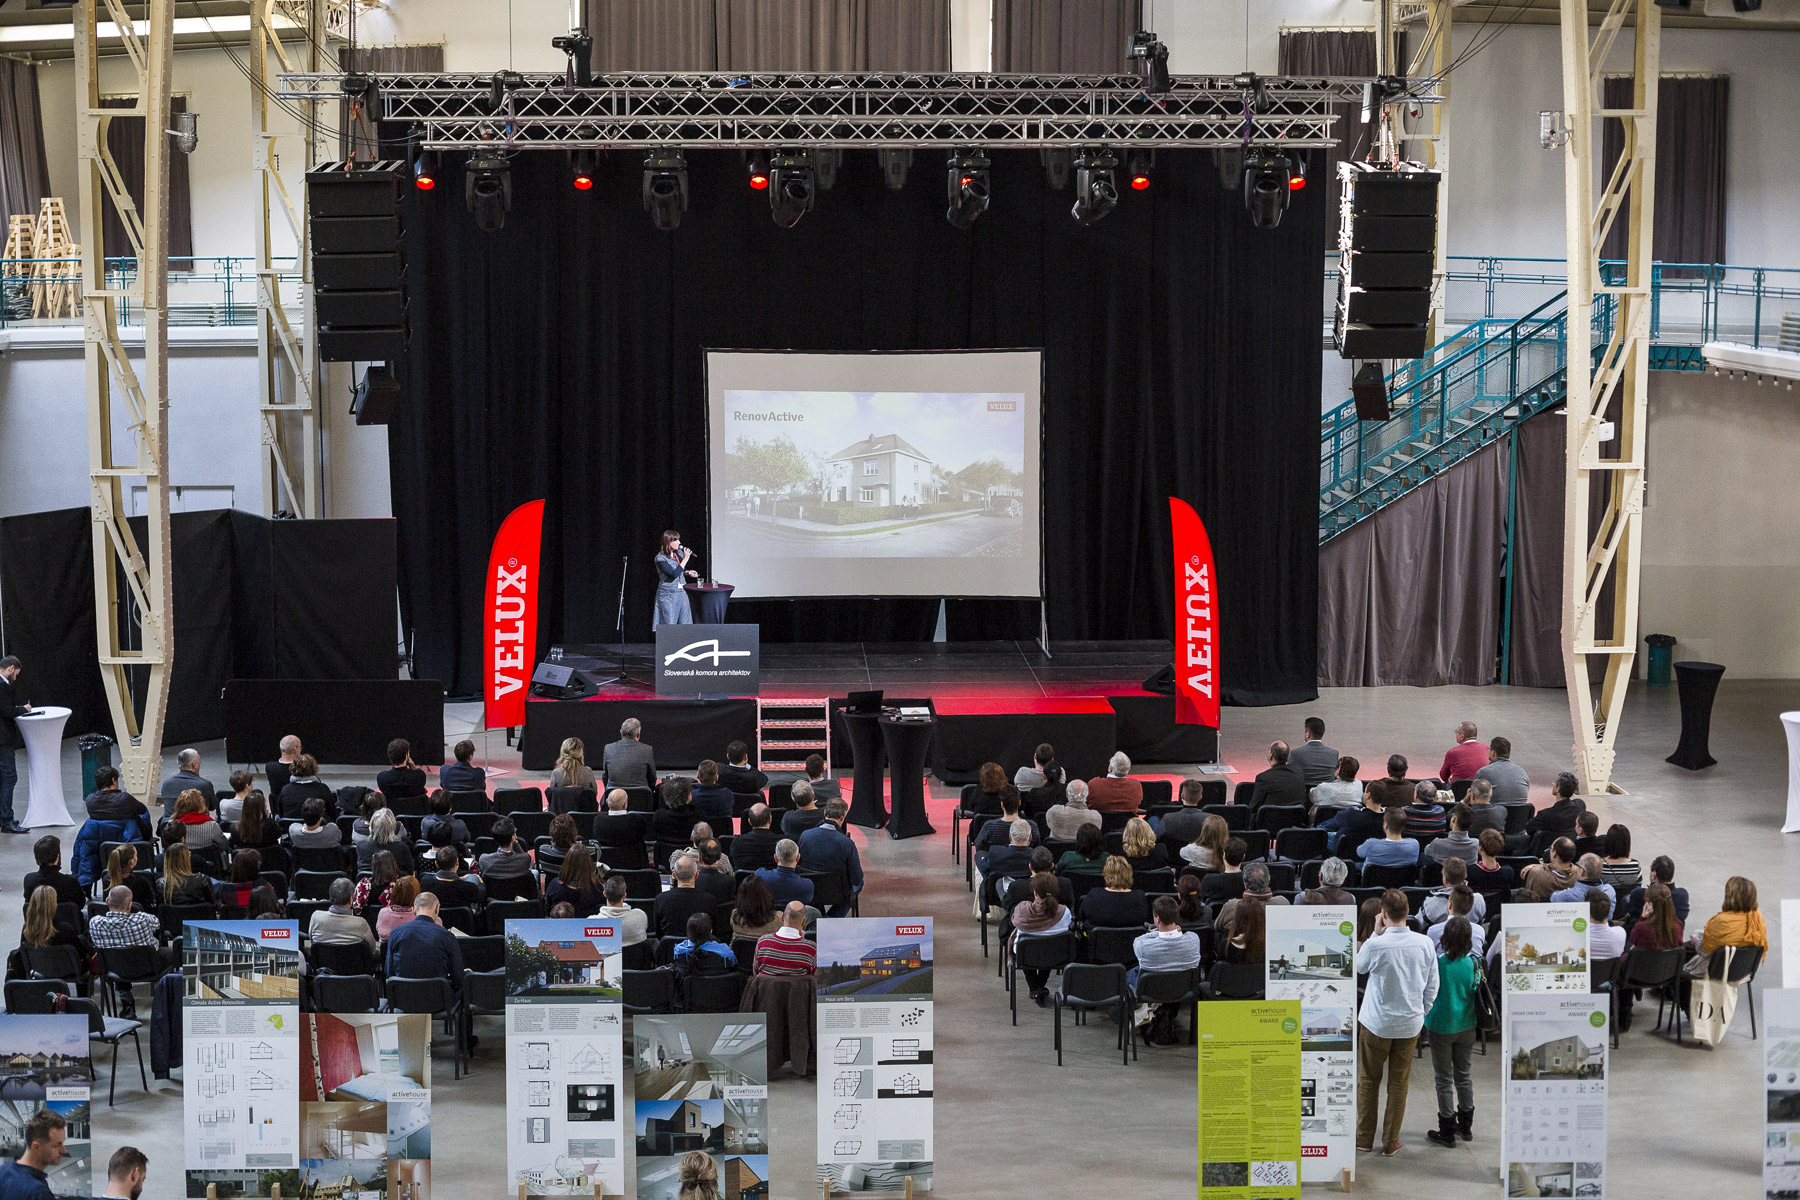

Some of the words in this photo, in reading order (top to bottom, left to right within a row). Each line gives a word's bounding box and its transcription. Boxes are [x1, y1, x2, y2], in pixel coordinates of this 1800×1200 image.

[733, 410, 804, 422] RenovActive
[663, 669, 694, 677] Slovenská
[718, 669, 751, 677] architektov
[1559, 1000, 1595, 1008] activehouse
[391, 1090, 427, 1098] activehouse
[1301, 1147, 1325, 1155] ELUX
